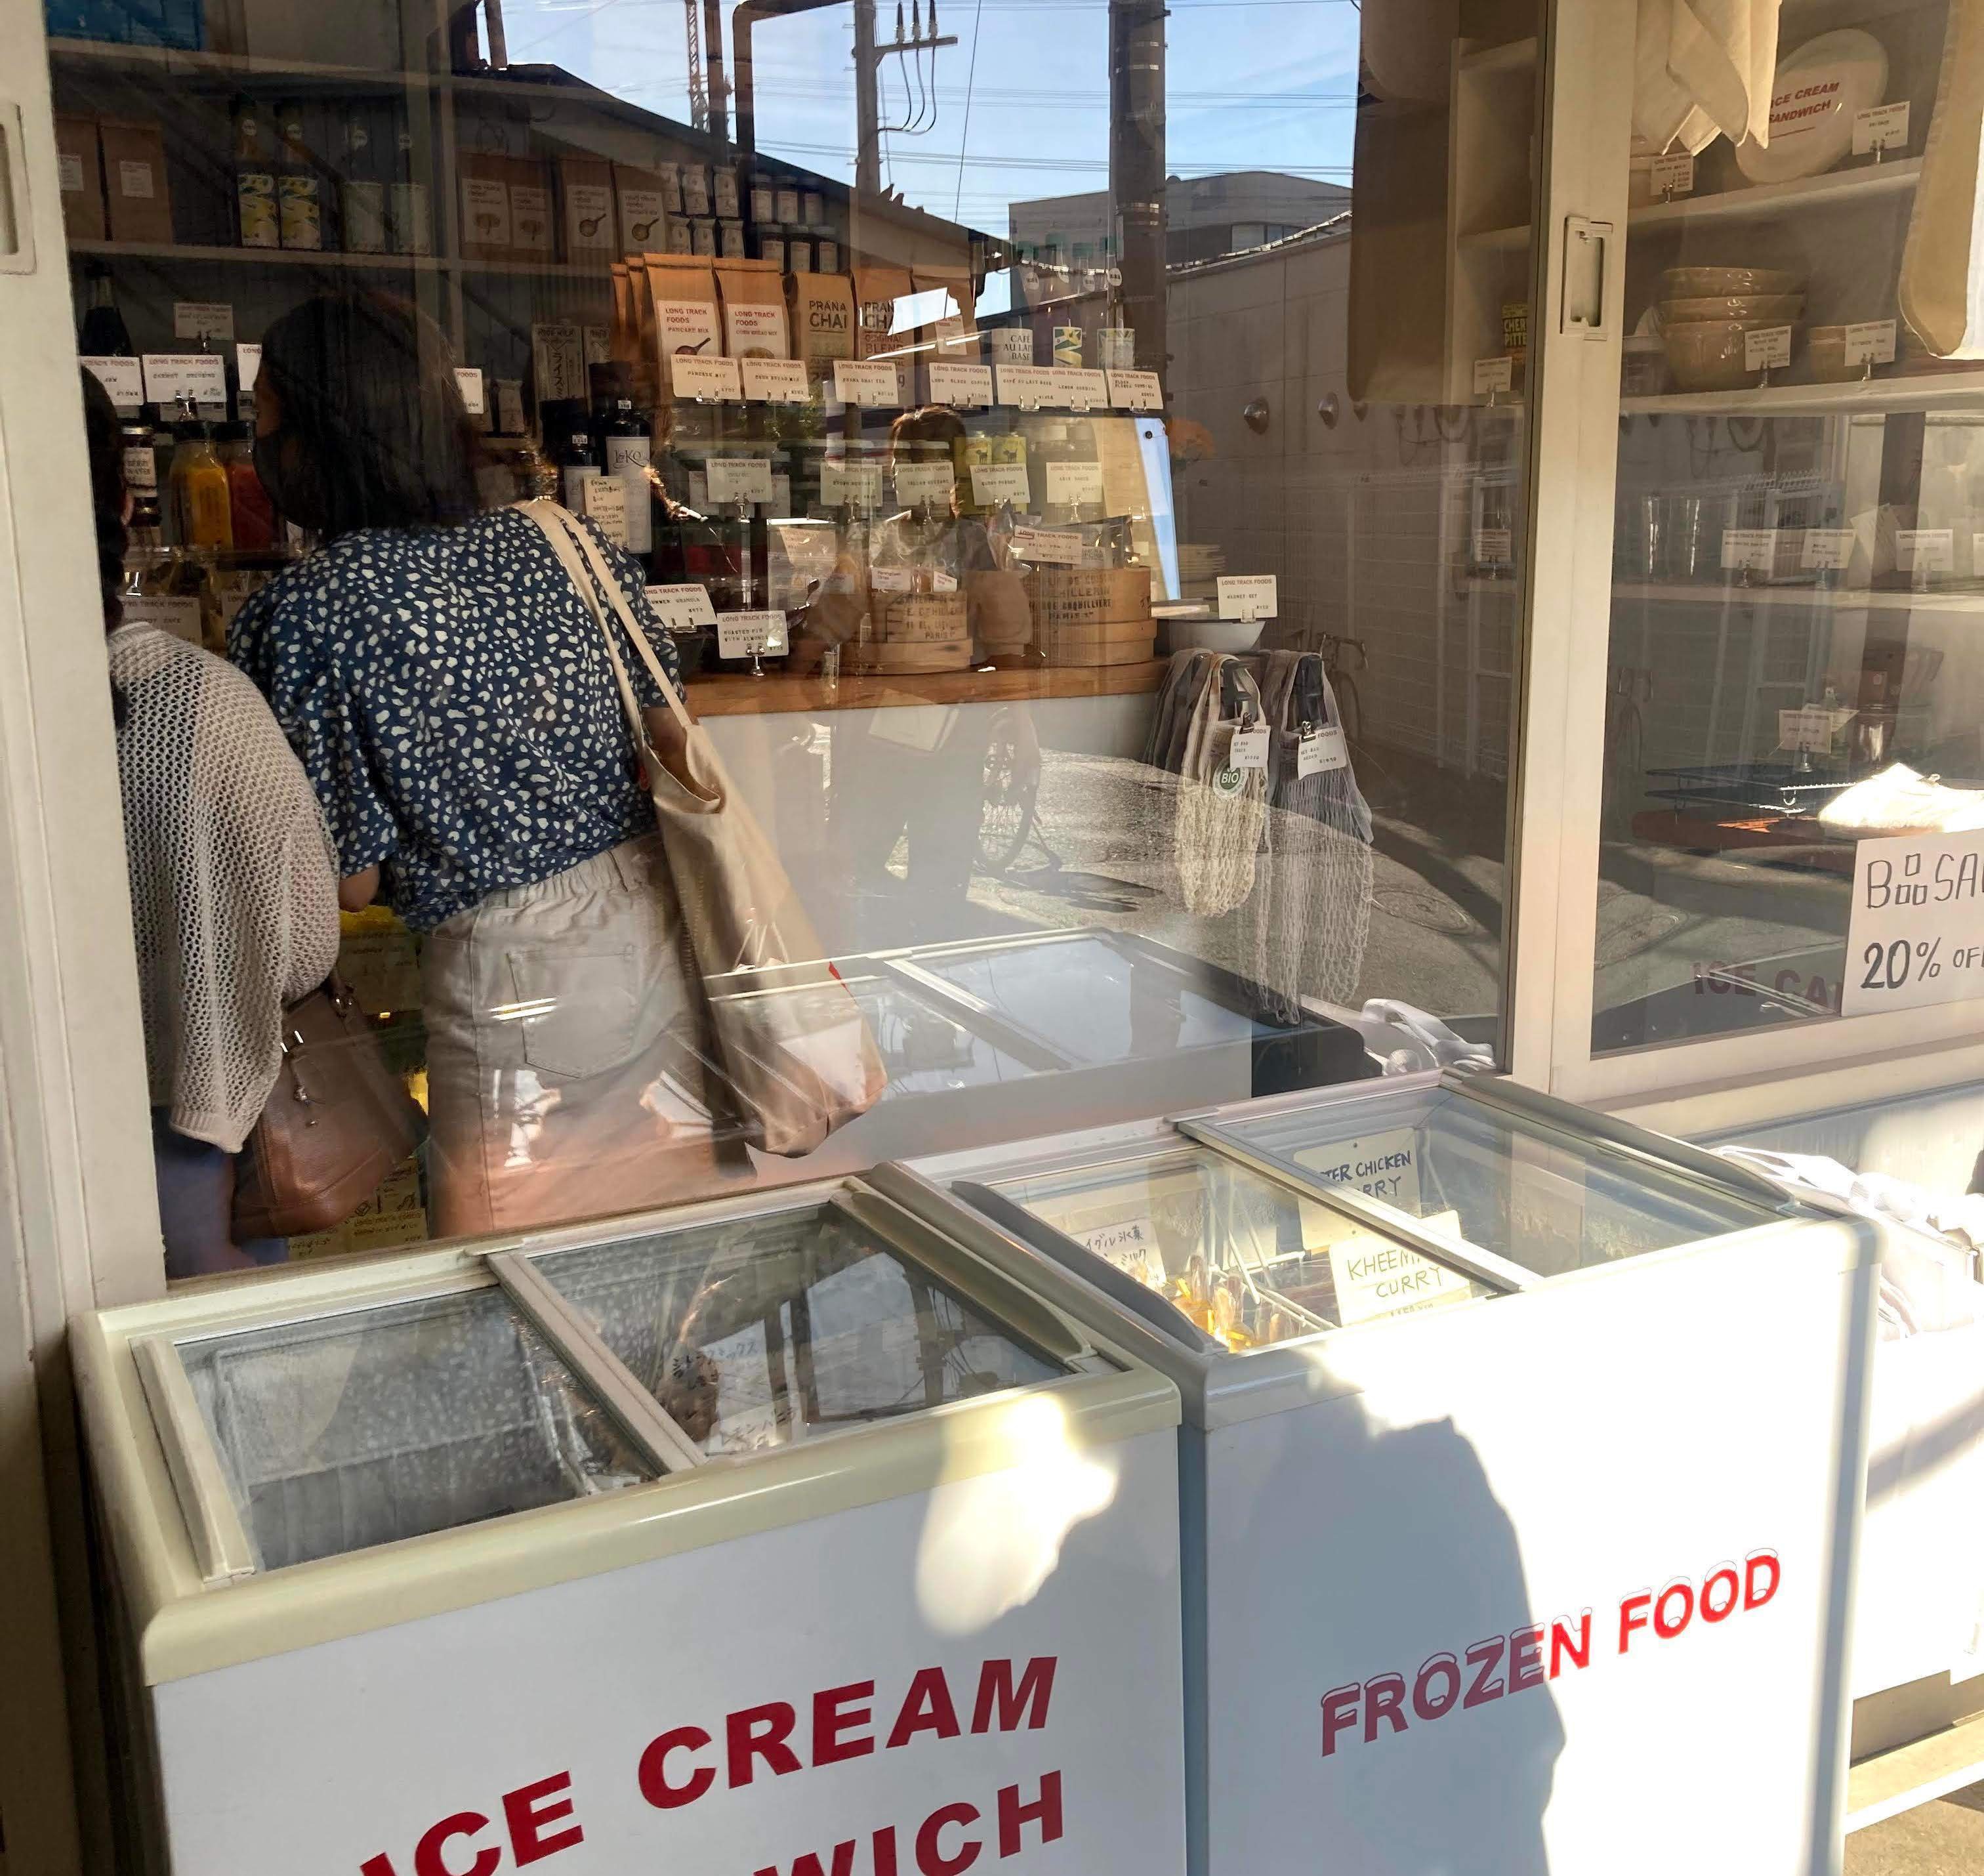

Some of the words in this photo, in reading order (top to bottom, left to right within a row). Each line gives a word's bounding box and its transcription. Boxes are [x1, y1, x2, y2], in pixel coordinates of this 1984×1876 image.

[1795, 82, 1840, 100] CREAM
[1769, 99, 1832, 124] SANDWICH
[809, 301, 847, 312] PRANA
[865, 301, 894, 312] PRAN
[809, 312, 847, 328] CHAI
[865, 314, 893, 329] CHA
[865, 333, 903, 343] ORIGINAL
[865, 344, 903, 354] BLEND
[1317, 730, 1338, 738] FOODS
[1861, 937, 1941, 990] 20%
[1691, 960, 1756, 997] ICE
[1355, 1150, 1412, 1178] CHICKEN
[1357, 1176, 1401, 1198] RRY
[1347, 1248, 1420, 1281] KHEEM
[1376, 1266, 1444, 1299] CURRY
[1319, 1606, 1593, 1758] FROZEN
[1618, 1547, 1781, 1655] FOOD
[637, 1656, 1059, 1810] CREAM
